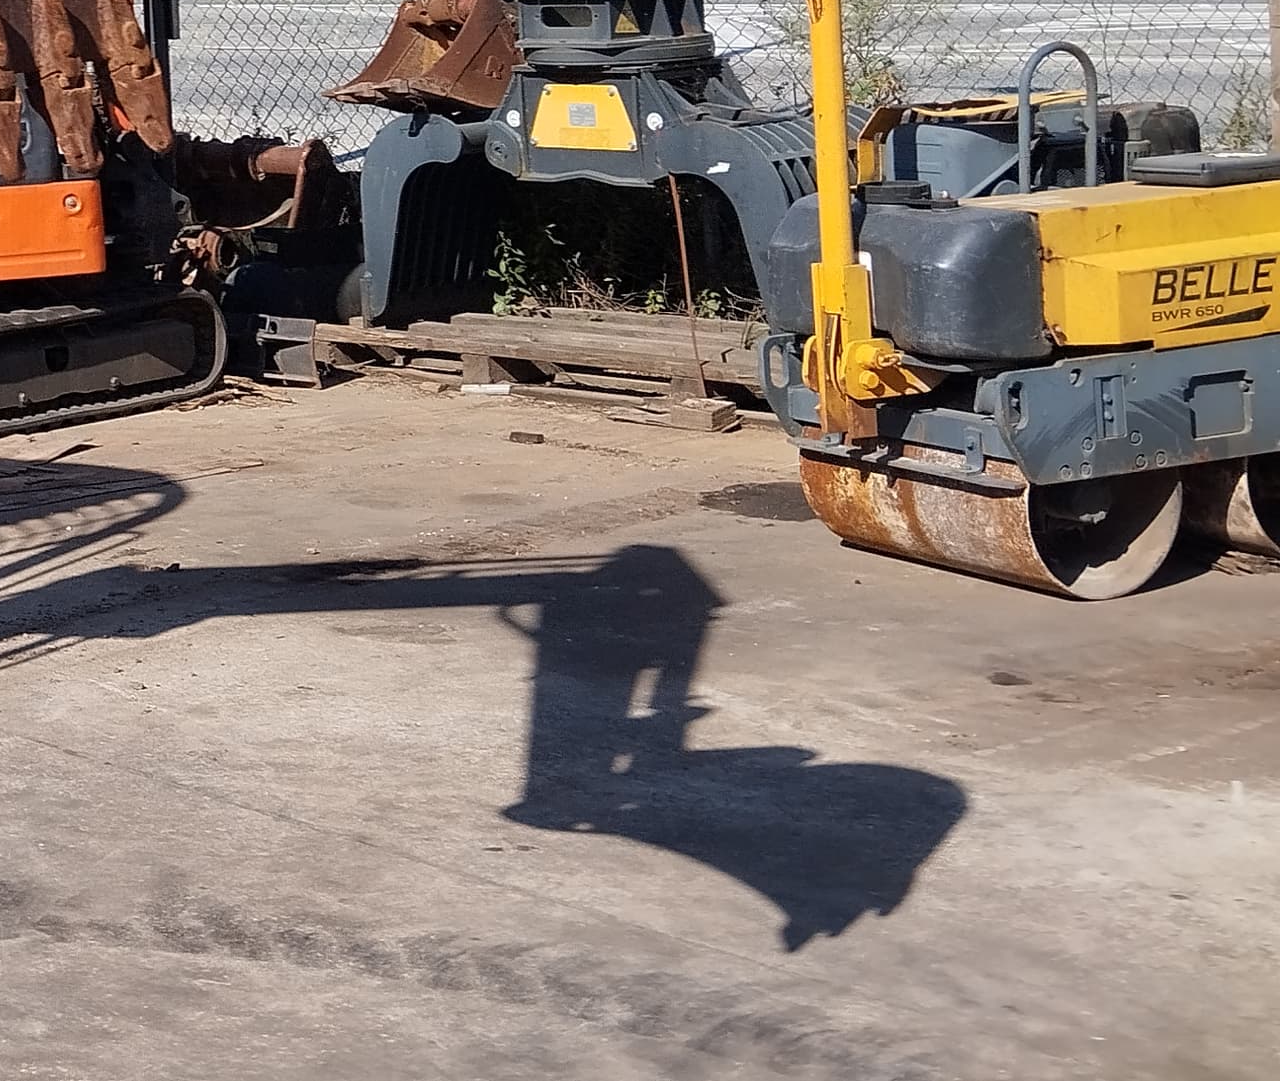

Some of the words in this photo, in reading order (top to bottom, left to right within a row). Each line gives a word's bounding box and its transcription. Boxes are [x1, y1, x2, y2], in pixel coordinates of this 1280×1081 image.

[1152, 258, 1277, 305] BELLE
[1152, 308, 1191, 322] BWR
[1195, 304, 1224, 317] 650
